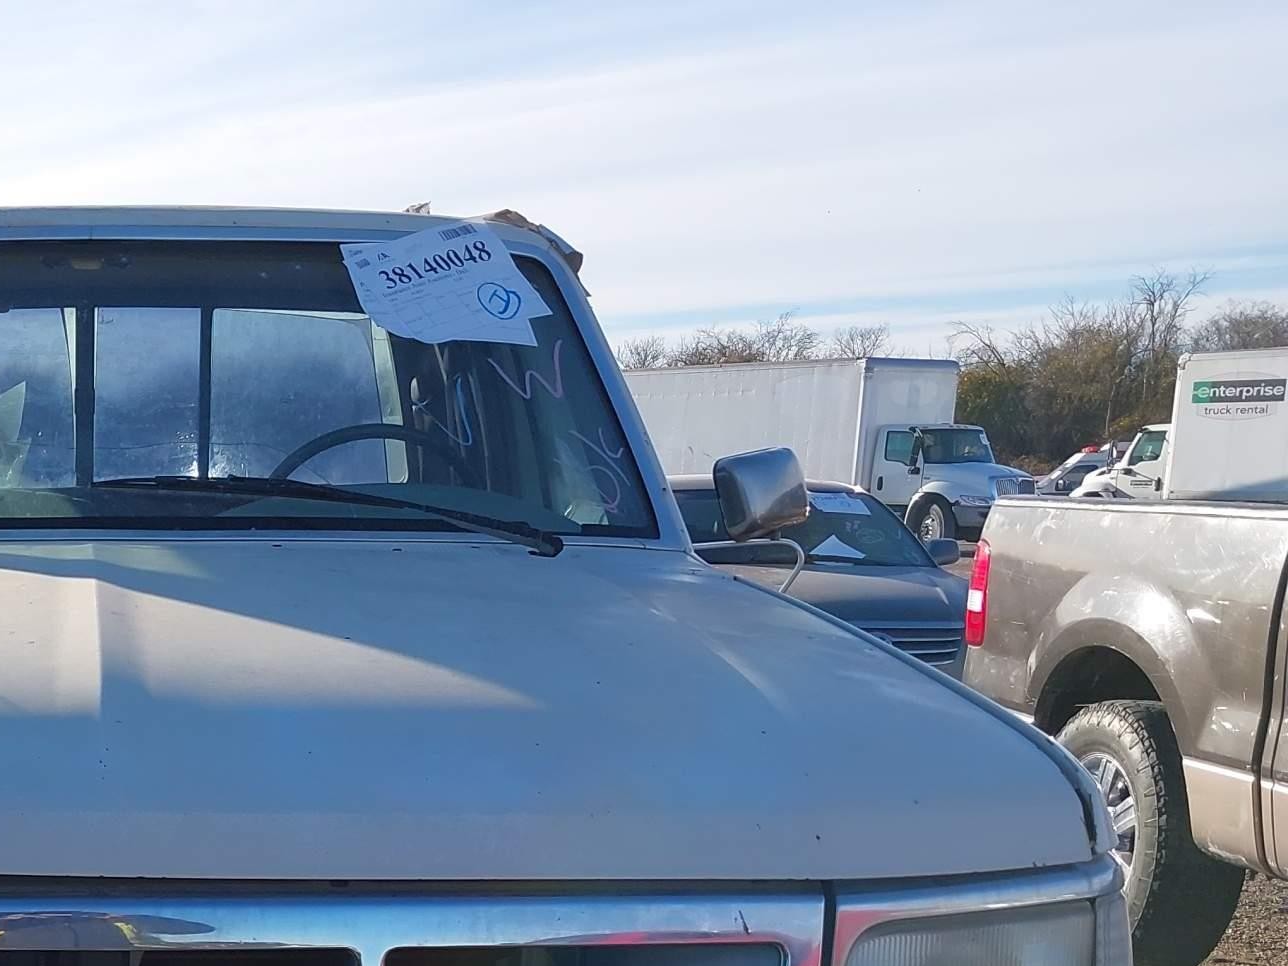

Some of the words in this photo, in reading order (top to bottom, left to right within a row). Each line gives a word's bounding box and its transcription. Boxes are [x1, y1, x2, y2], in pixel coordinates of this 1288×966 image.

[378, 240, 492, 290] 38140048
[1196, 382, 1285, 400] enterprise
[1204, 405, 1232, 416] truck
[1235, 404, 1269, 415] rental
